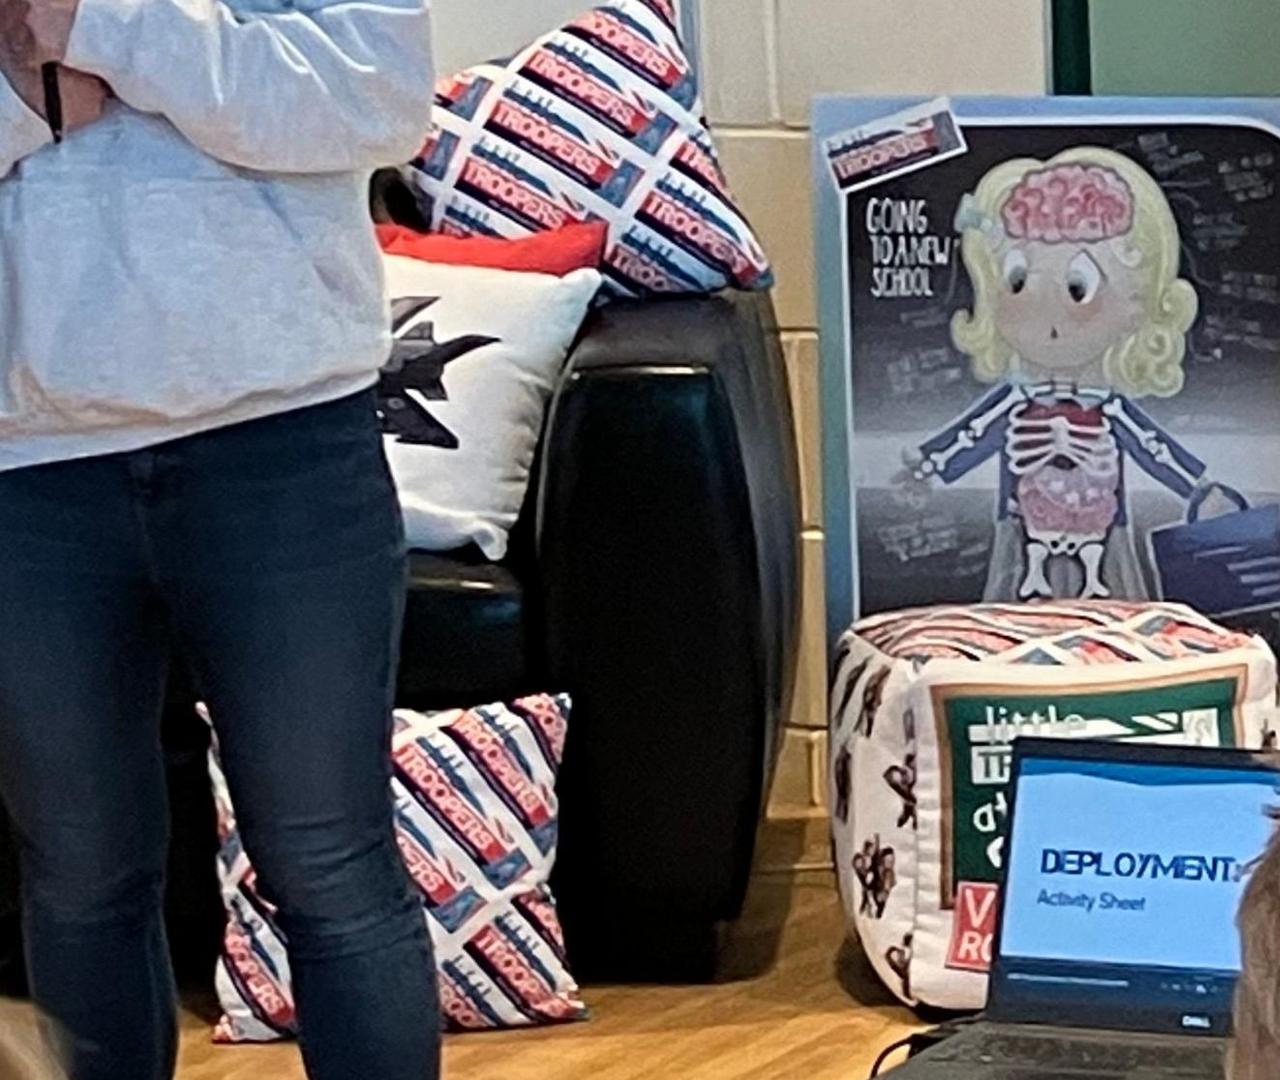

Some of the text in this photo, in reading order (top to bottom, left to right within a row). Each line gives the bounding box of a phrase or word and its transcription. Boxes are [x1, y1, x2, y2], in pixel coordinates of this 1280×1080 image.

[866, 197, 929, 234] GOING
[869, 236, 893, 265] TO
[910, 236, 951, 265] NEW
[870, 267, 934, 297] SCHOOL
[1036, 889, 1146, 912] Activity Sheet
